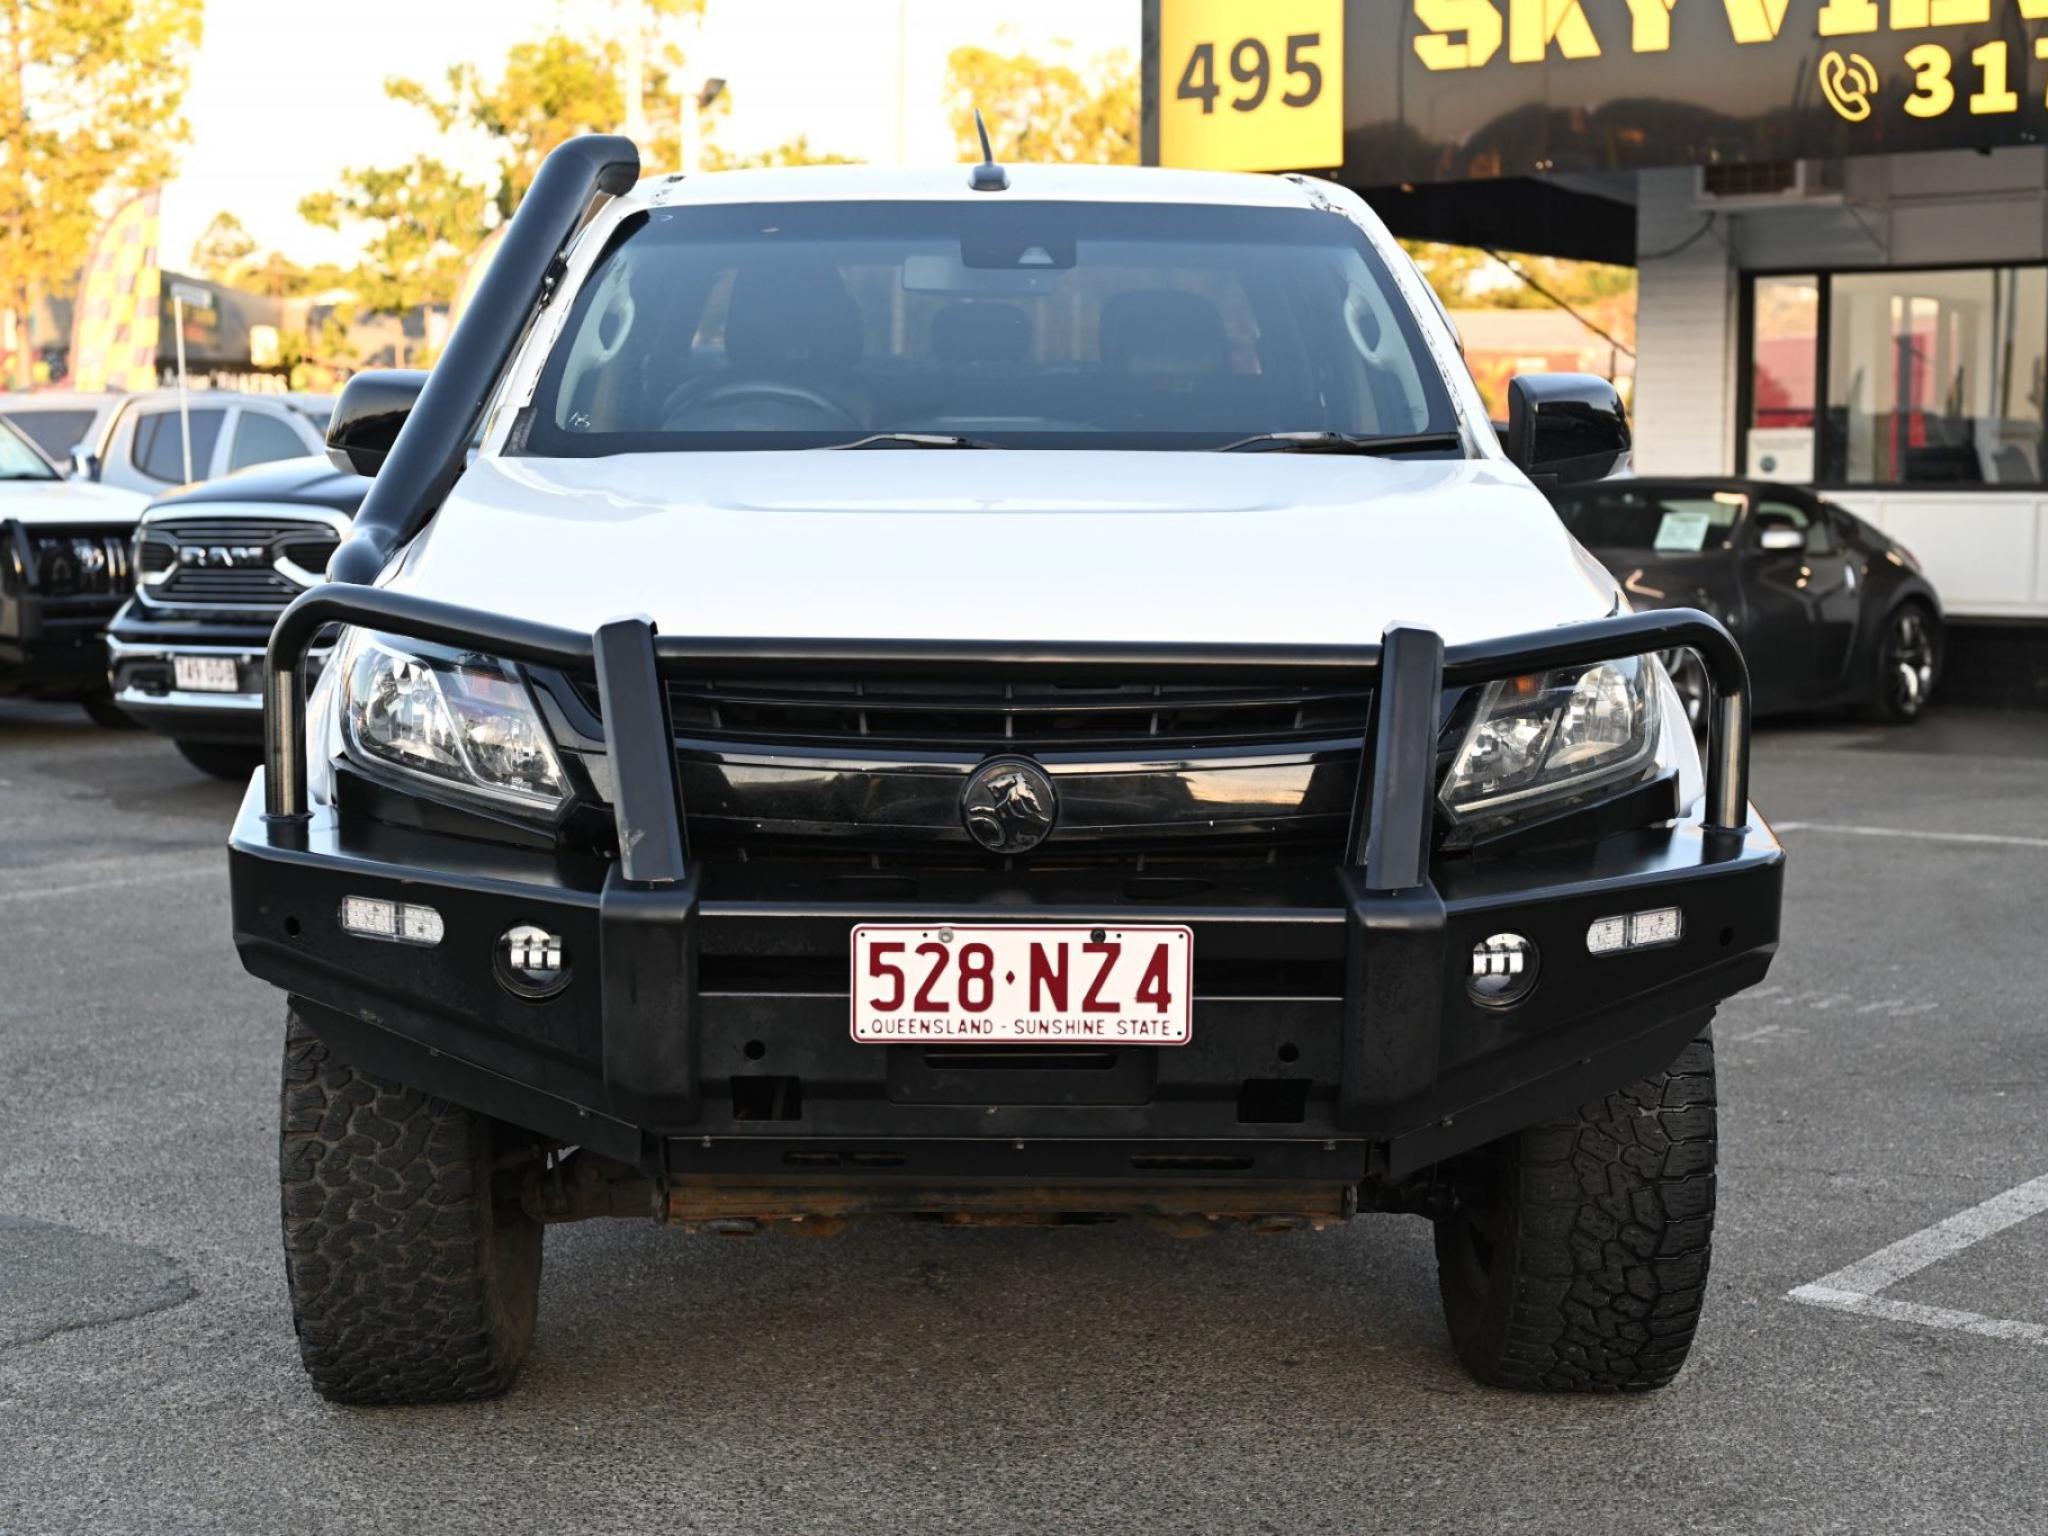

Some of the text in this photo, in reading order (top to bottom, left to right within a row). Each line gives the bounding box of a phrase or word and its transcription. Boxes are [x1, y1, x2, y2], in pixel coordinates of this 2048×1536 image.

[1177, 33, 1322, 115] 495
[1903, 37, 2048, 118] 31
[871, 1018, 994, 1035] QUEENSLAND
[1014, 1019, 1105, 1035] SUNSHINE
[1116, 1019, 1171, 1036] STATE
